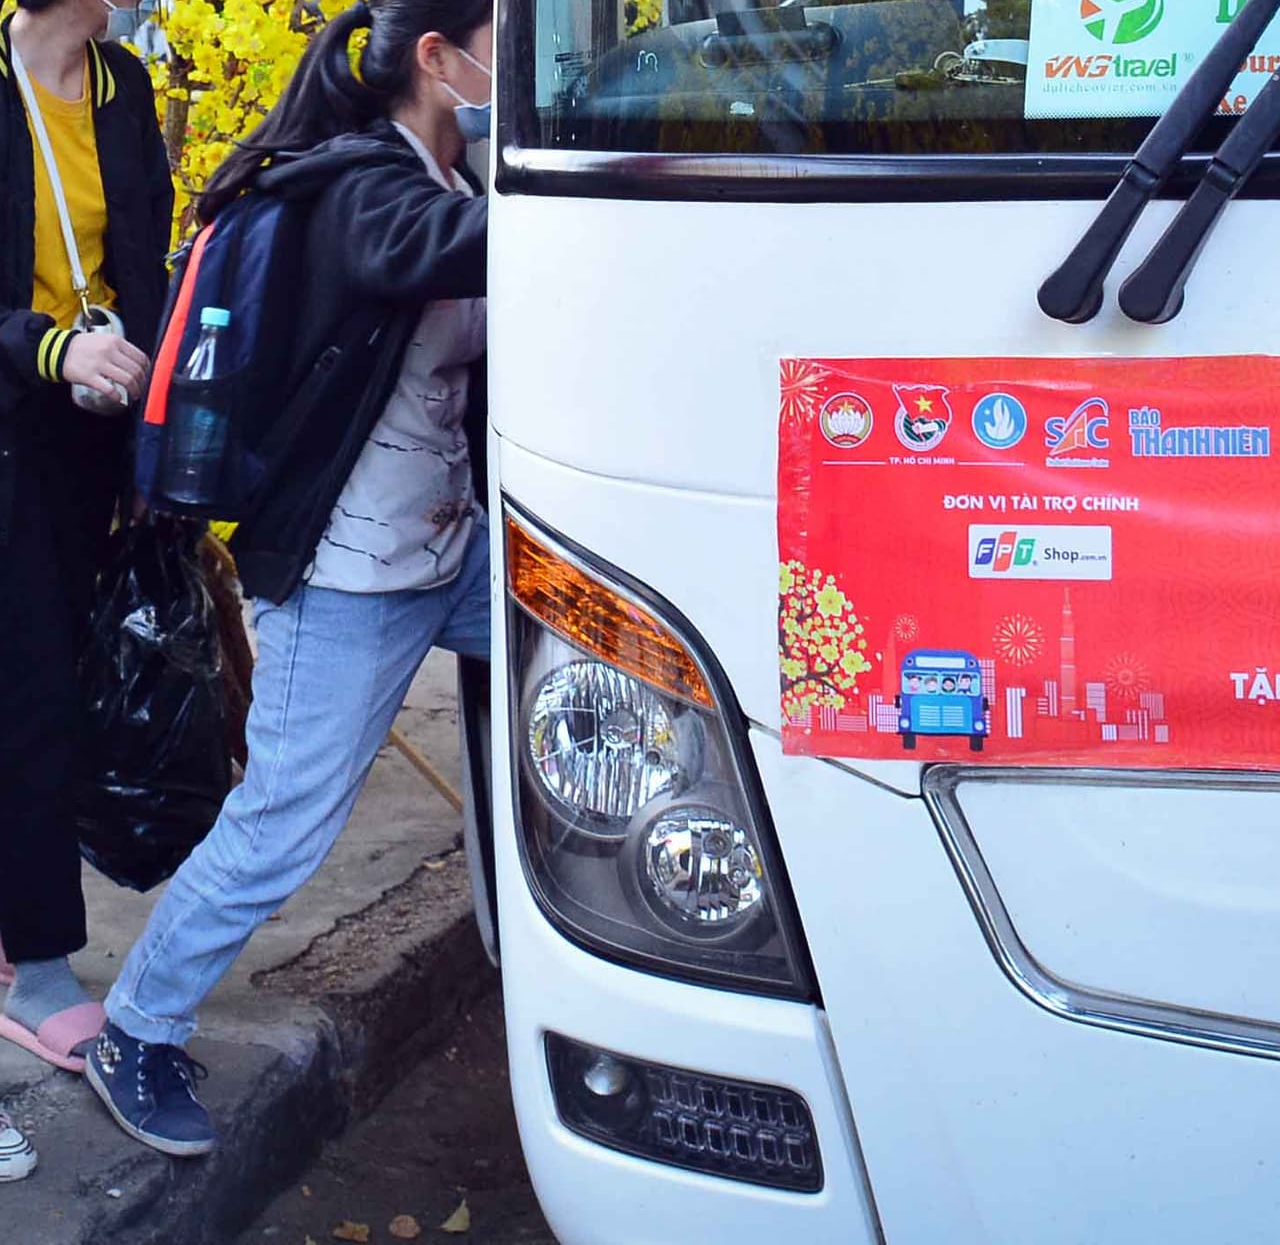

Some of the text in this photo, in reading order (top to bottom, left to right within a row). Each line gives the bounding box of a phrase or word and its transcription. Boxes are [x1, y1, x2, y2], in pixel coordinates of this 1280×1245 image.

[943, 493, 1139, 514] ĐƠN VỊ TÀI TRỢ CHÍNH
[975, 531, 1035, 572] FPT
